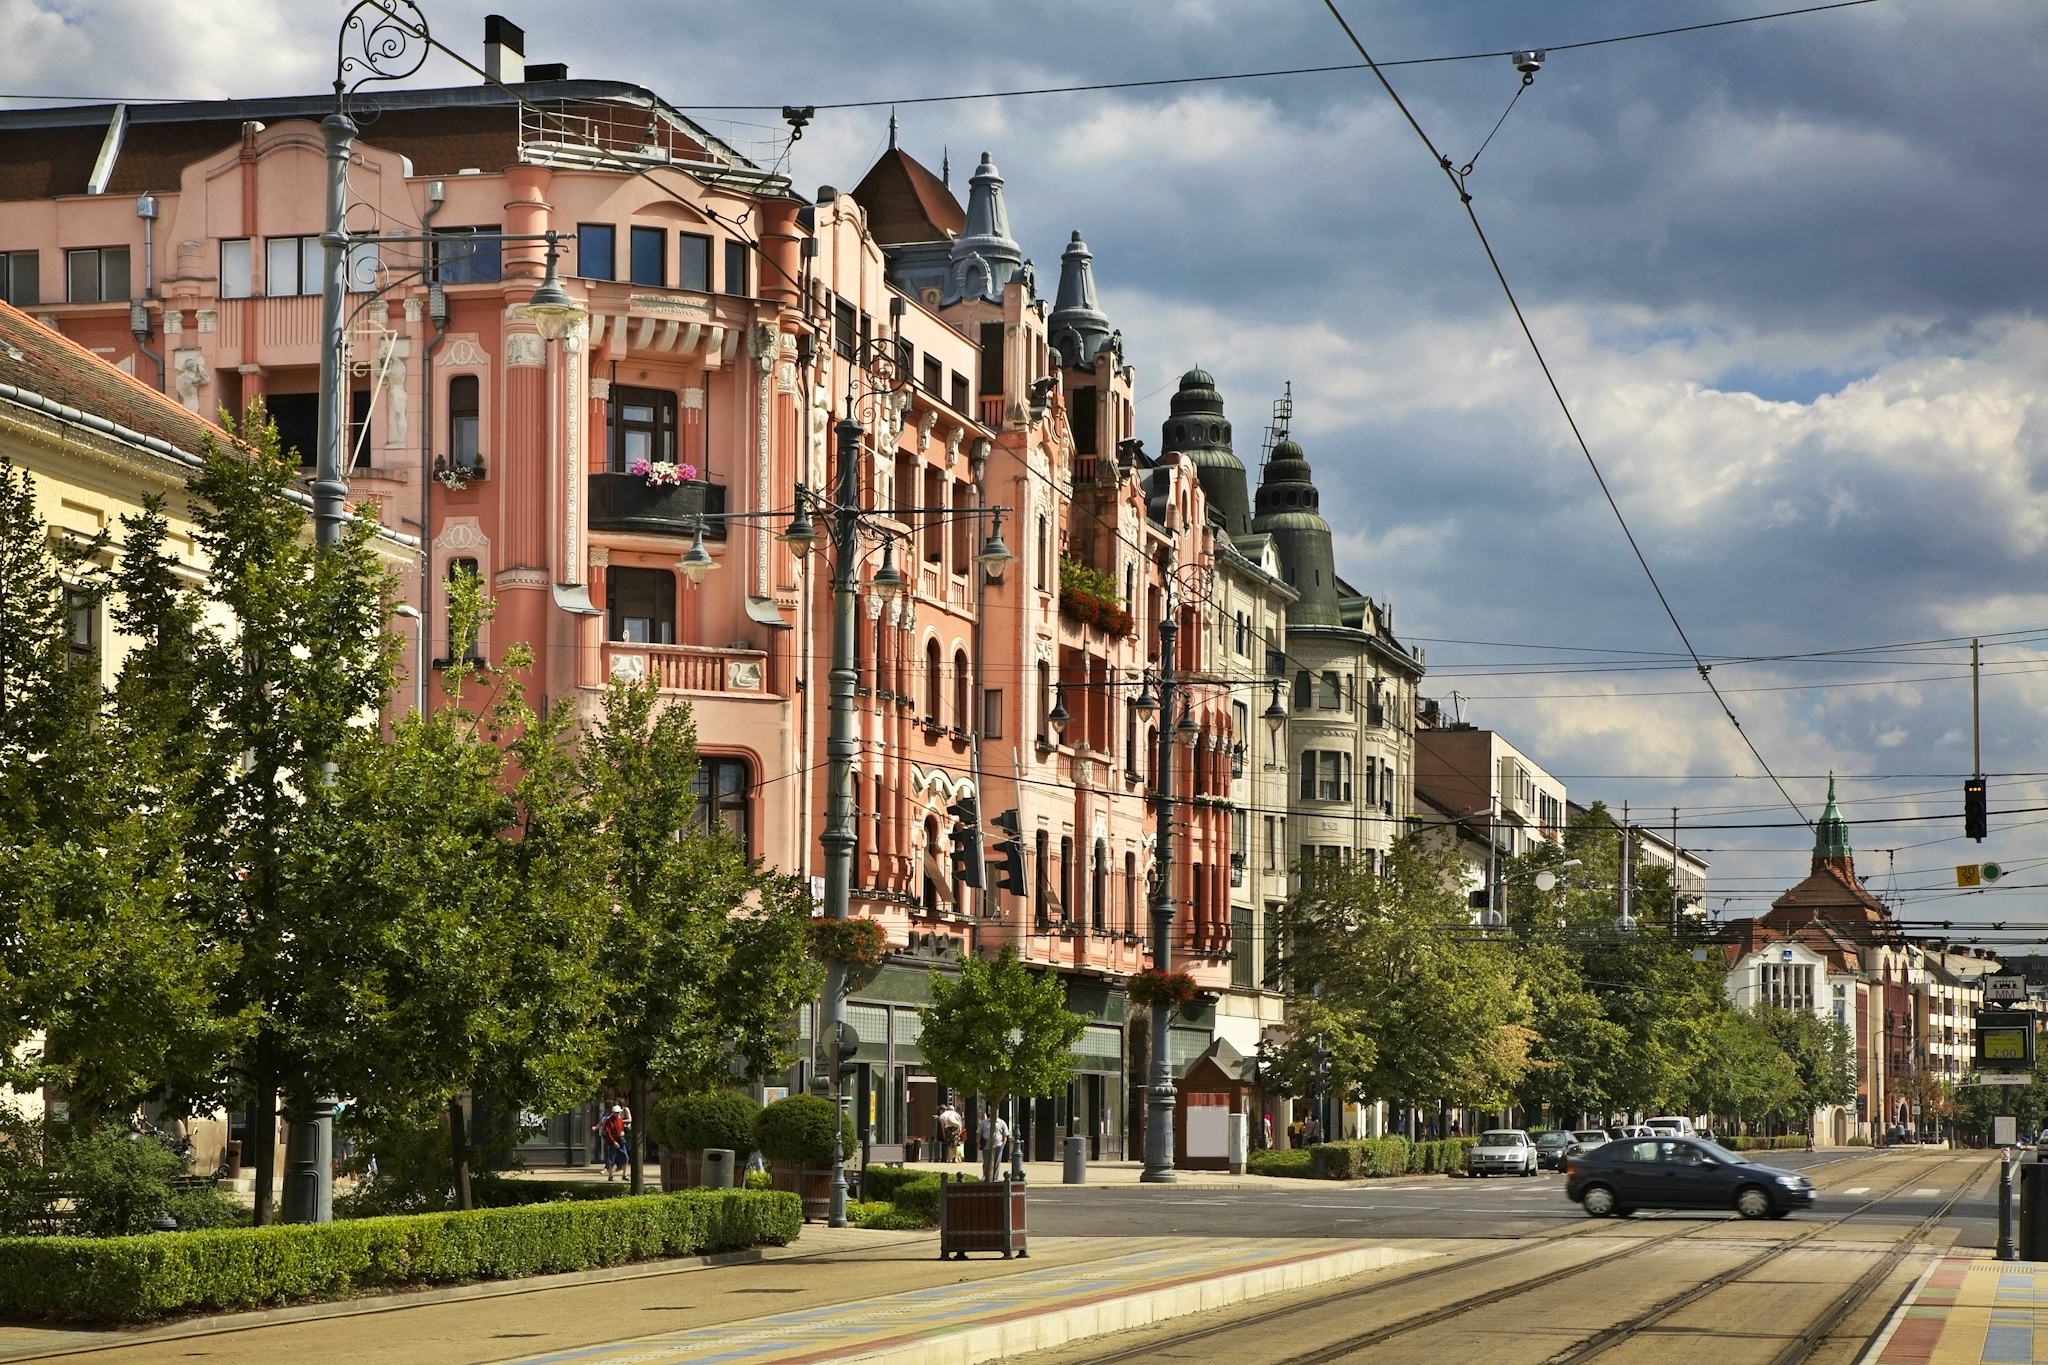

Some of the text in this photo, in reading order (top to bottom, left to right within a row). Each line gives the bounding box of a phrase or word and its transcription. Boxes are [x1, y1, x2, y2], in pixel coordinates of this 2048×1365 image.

[1961, 867, 1975, 877] 20
[1996, 989, 2015, 998] MM
[1992, 1048, 2016, 1057] 2:00
